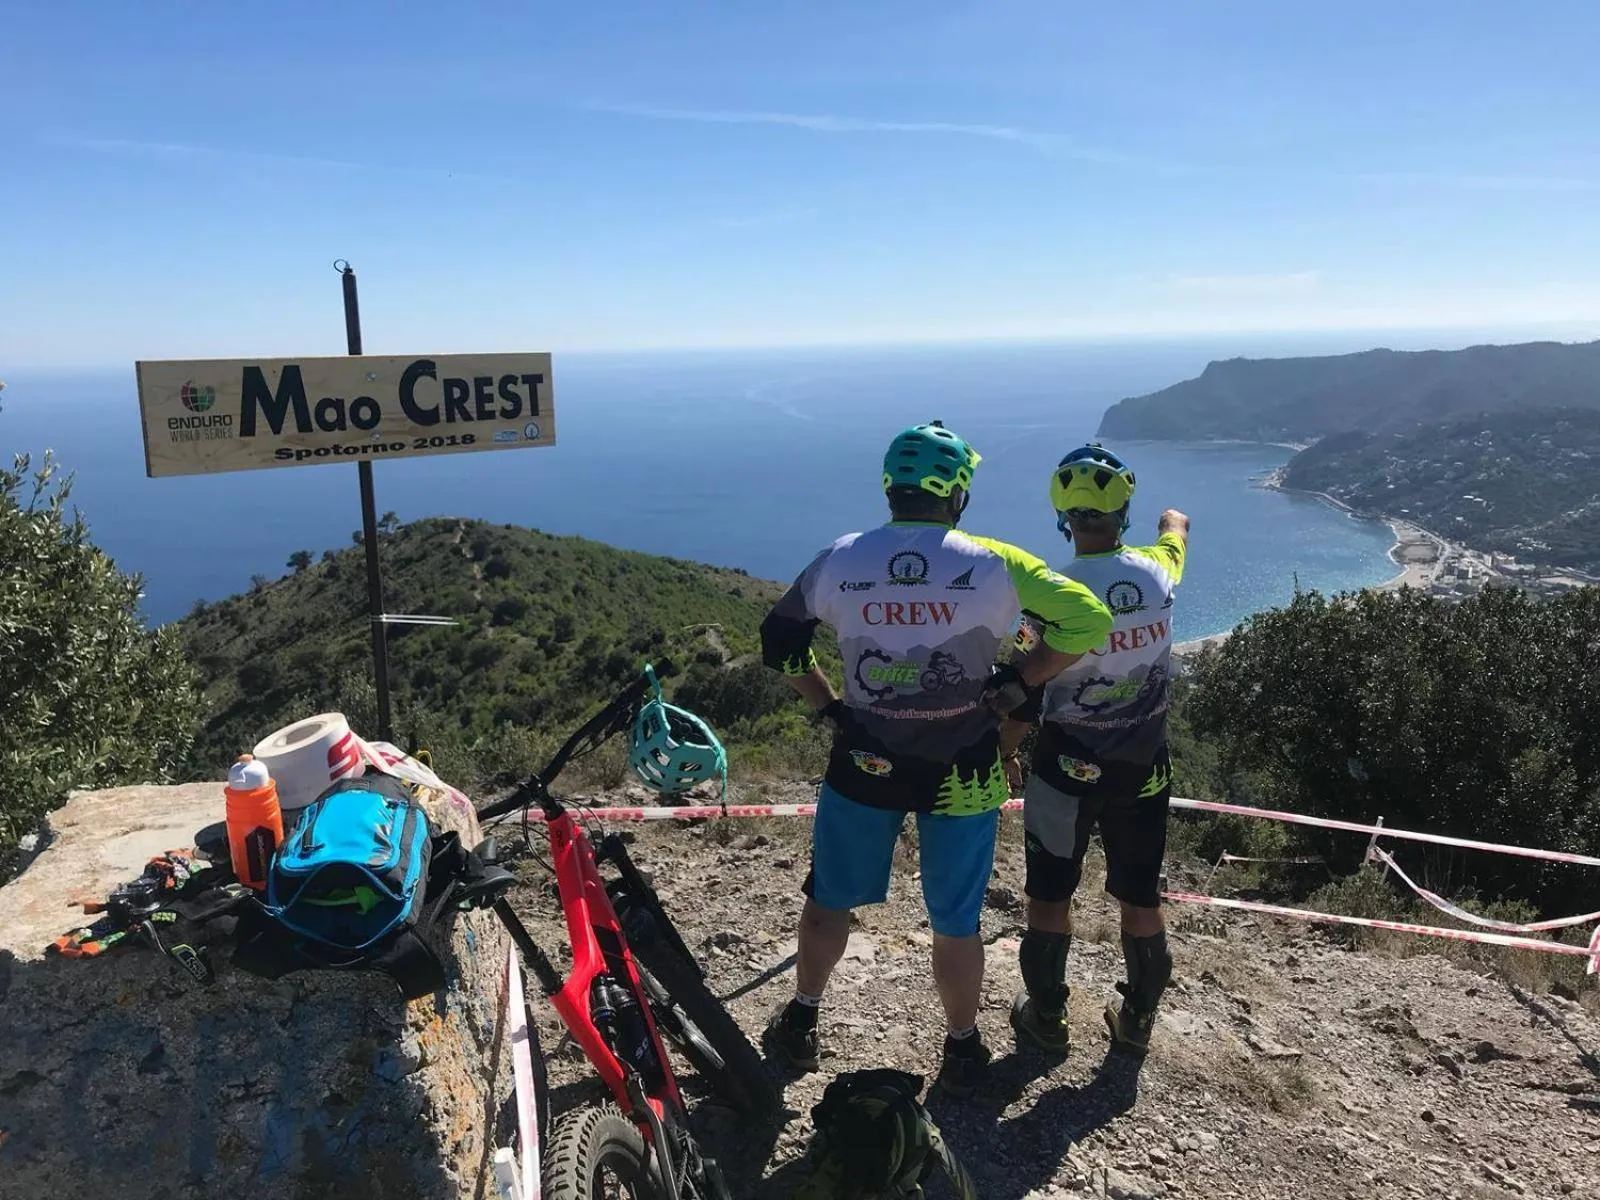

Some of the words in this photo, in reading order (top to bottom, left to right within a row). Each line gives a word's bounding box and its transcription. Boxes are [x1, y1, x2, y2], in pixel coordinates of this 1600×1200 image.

[239, 364, 382, 437] Mao
[399, 360, 544, 426] CREST
[170, 428, 201, 443] WORLD
[204, 427, 234, 441] SERIES
[275, 441, 406, 461] Spotorno
[413, 434, 476, 449] 2018
[862, 601, 959, 626] CREW
[1089, 618, 1170, 656] REW
